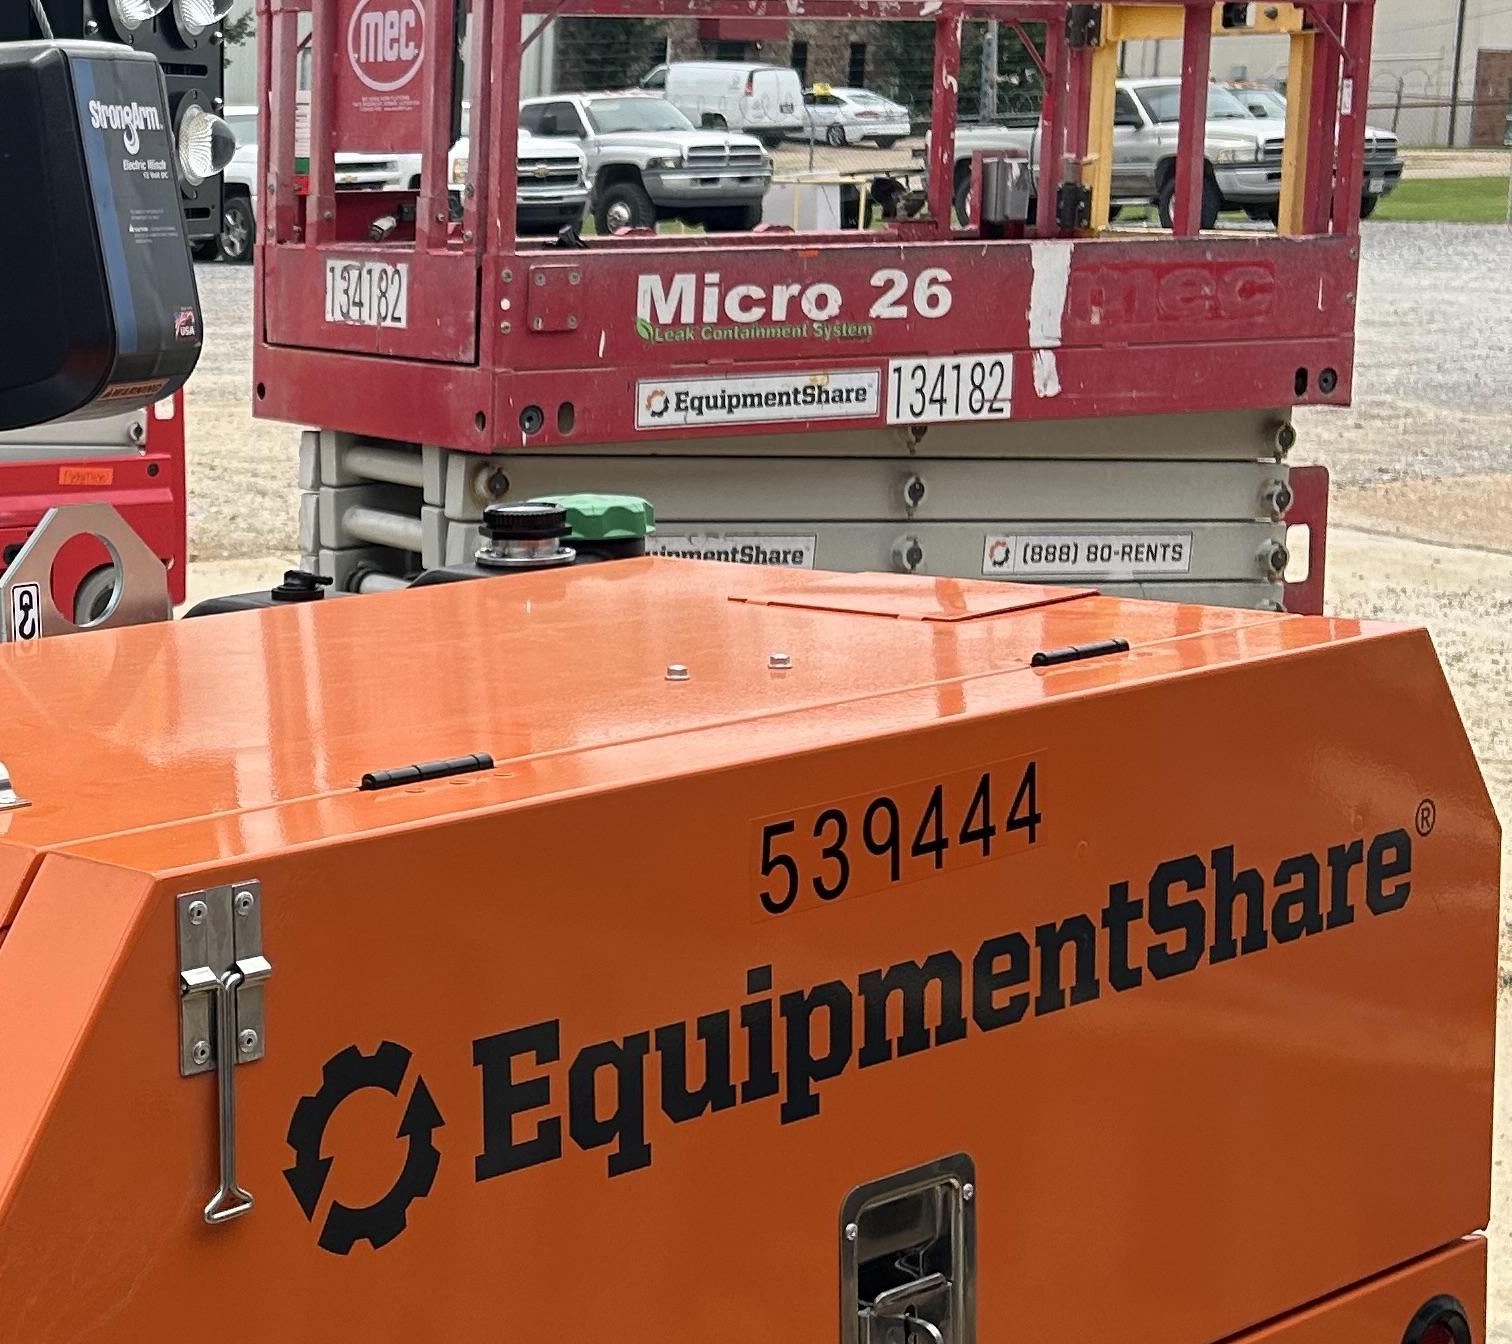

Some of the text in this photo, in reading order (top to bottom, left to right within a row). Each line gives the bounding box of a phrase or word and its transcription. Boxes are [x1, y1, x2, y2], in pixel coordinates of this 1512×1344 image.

[329, 264, 402, 324] 134182
[636, 267, 953, 324] Micro 26
[654, 322, 874, 343] Leak Containment System
[674, 383, 868, 416] EquipmentShare
[893, 361, 1006, 419] 134182
[1023, 542, 1184, 565] (888) 80-RENTS
[759, 761, 1043, 914] 539444
